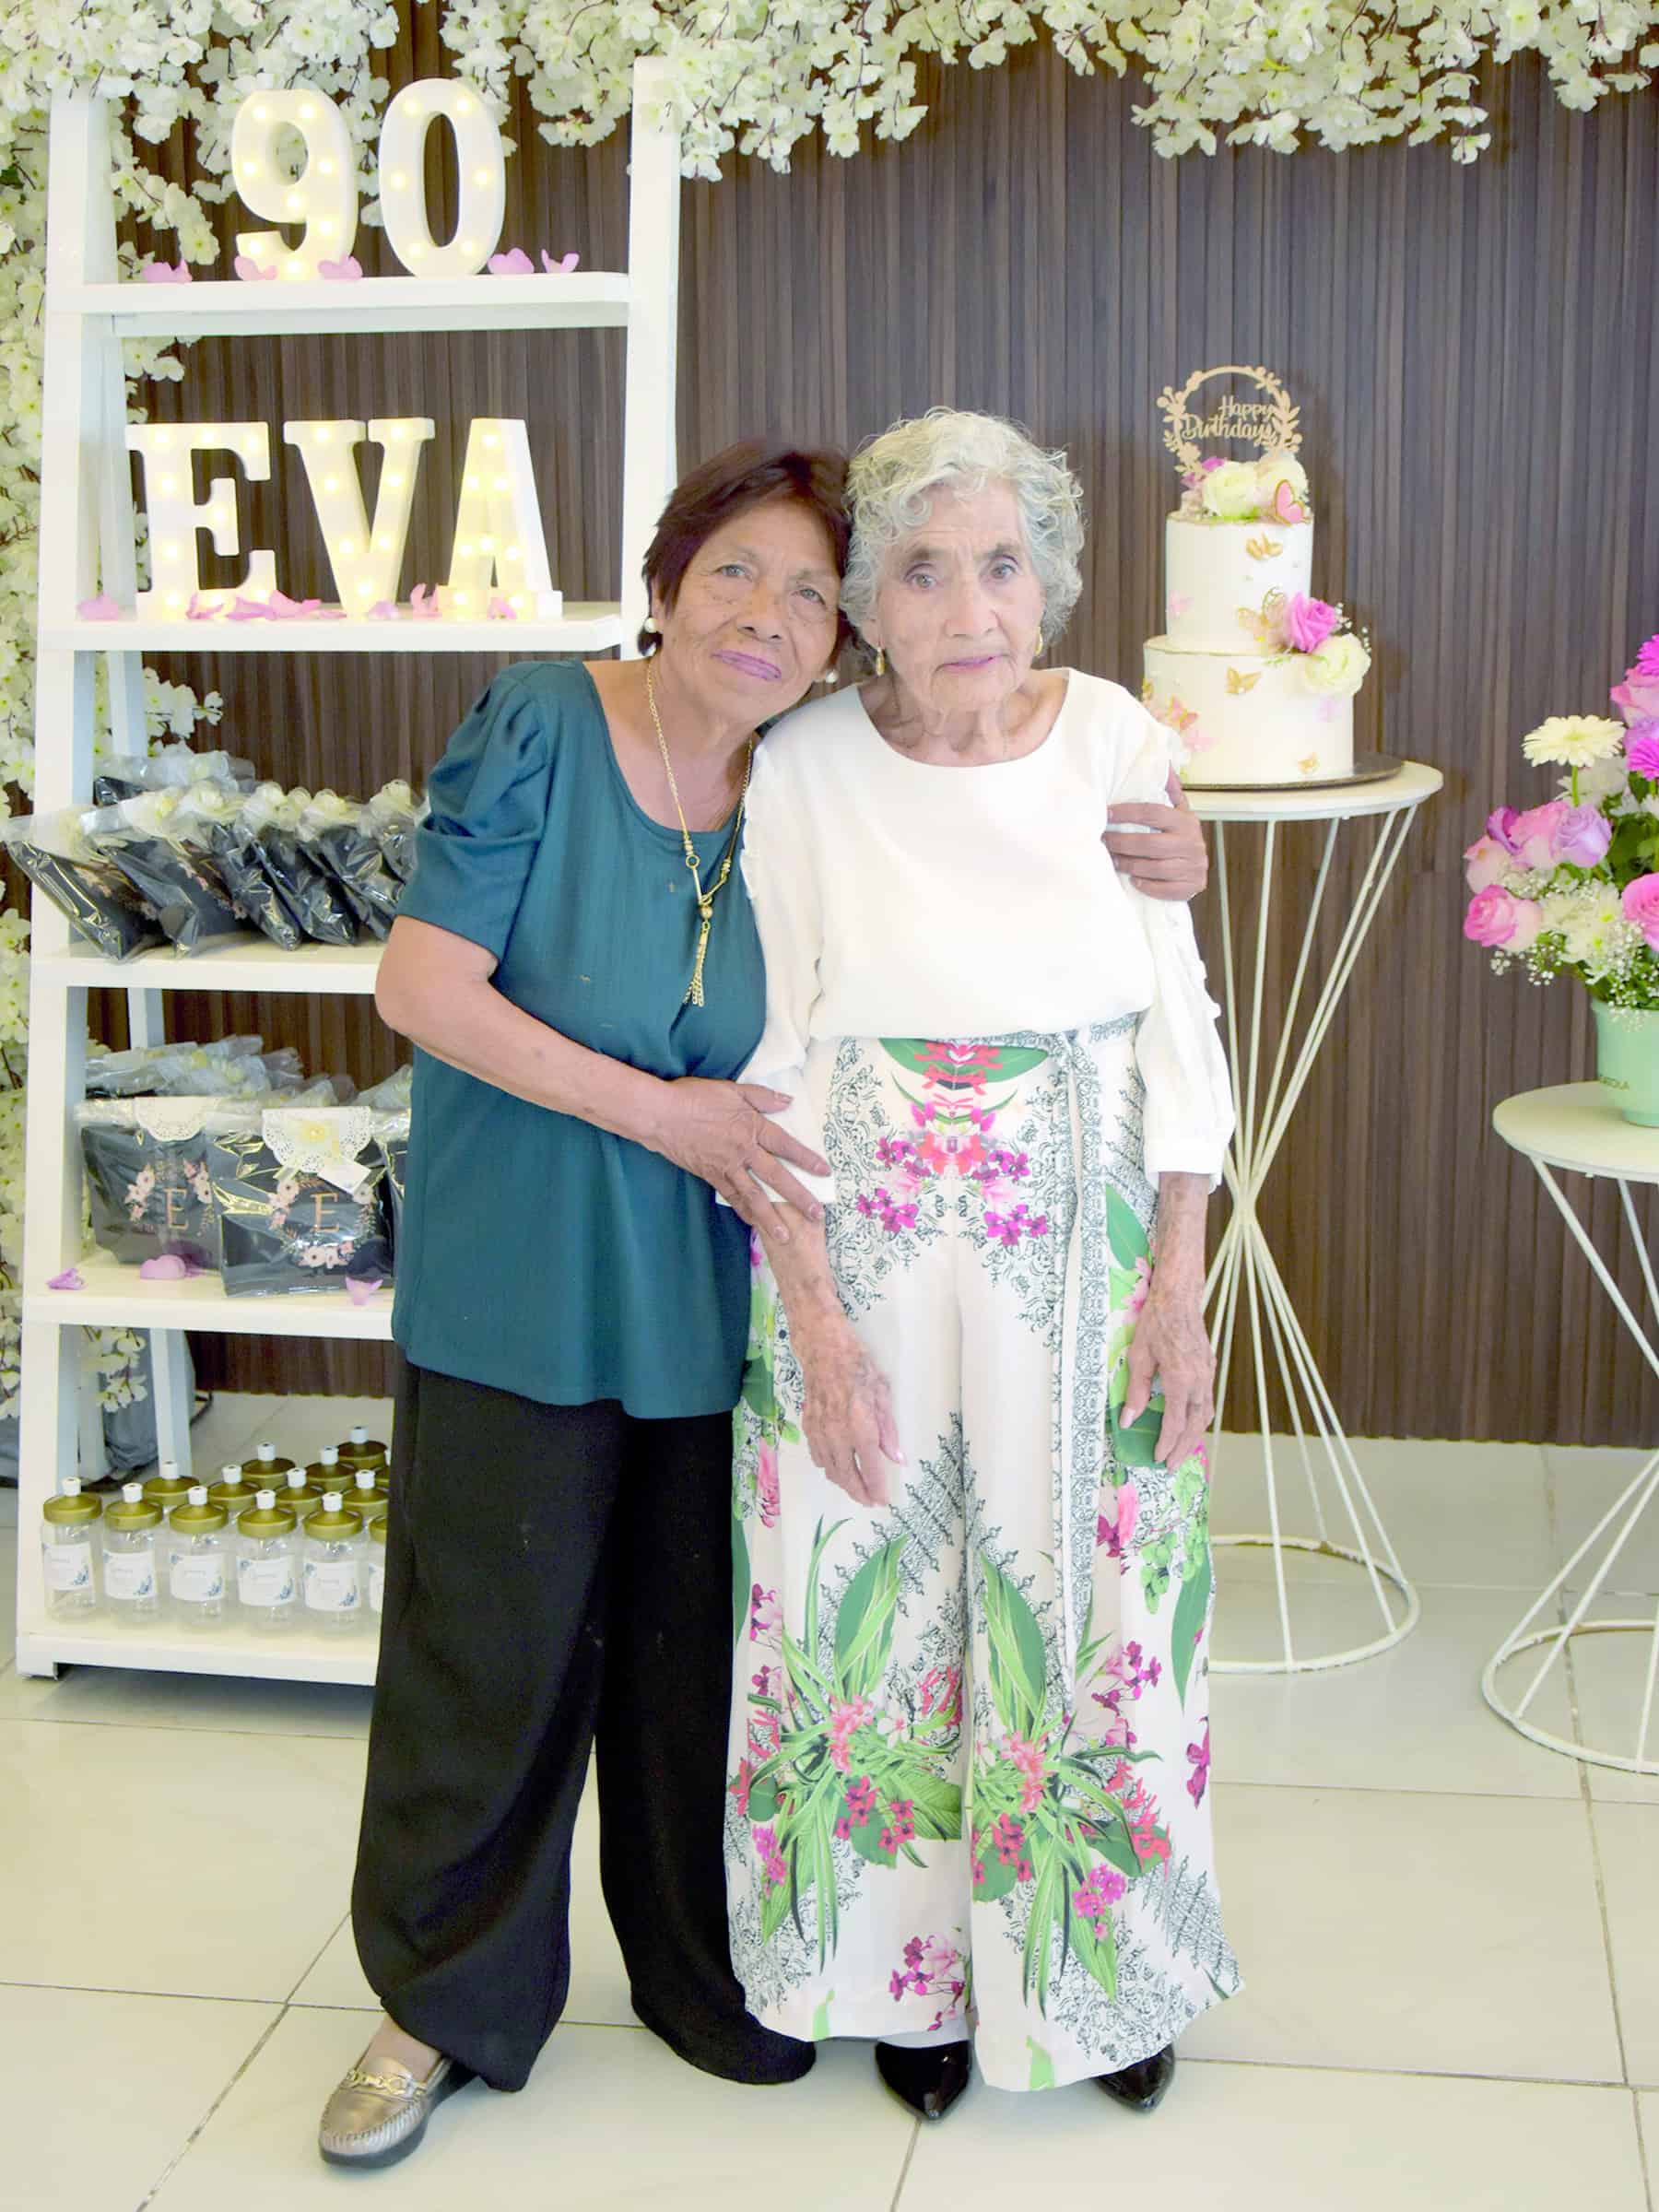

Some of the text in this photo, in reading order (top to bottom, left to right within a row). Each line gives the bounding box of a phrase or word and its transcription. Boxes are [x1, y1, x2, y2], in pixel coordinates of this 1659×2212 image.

[231, 78, 506, 278] 90
[1218, 394, 1273, 423] Happy
[125, 418, 563, 620] EVA
[163, 1187, 189, 1230] E
[310, 1191, 339, 1232] E
